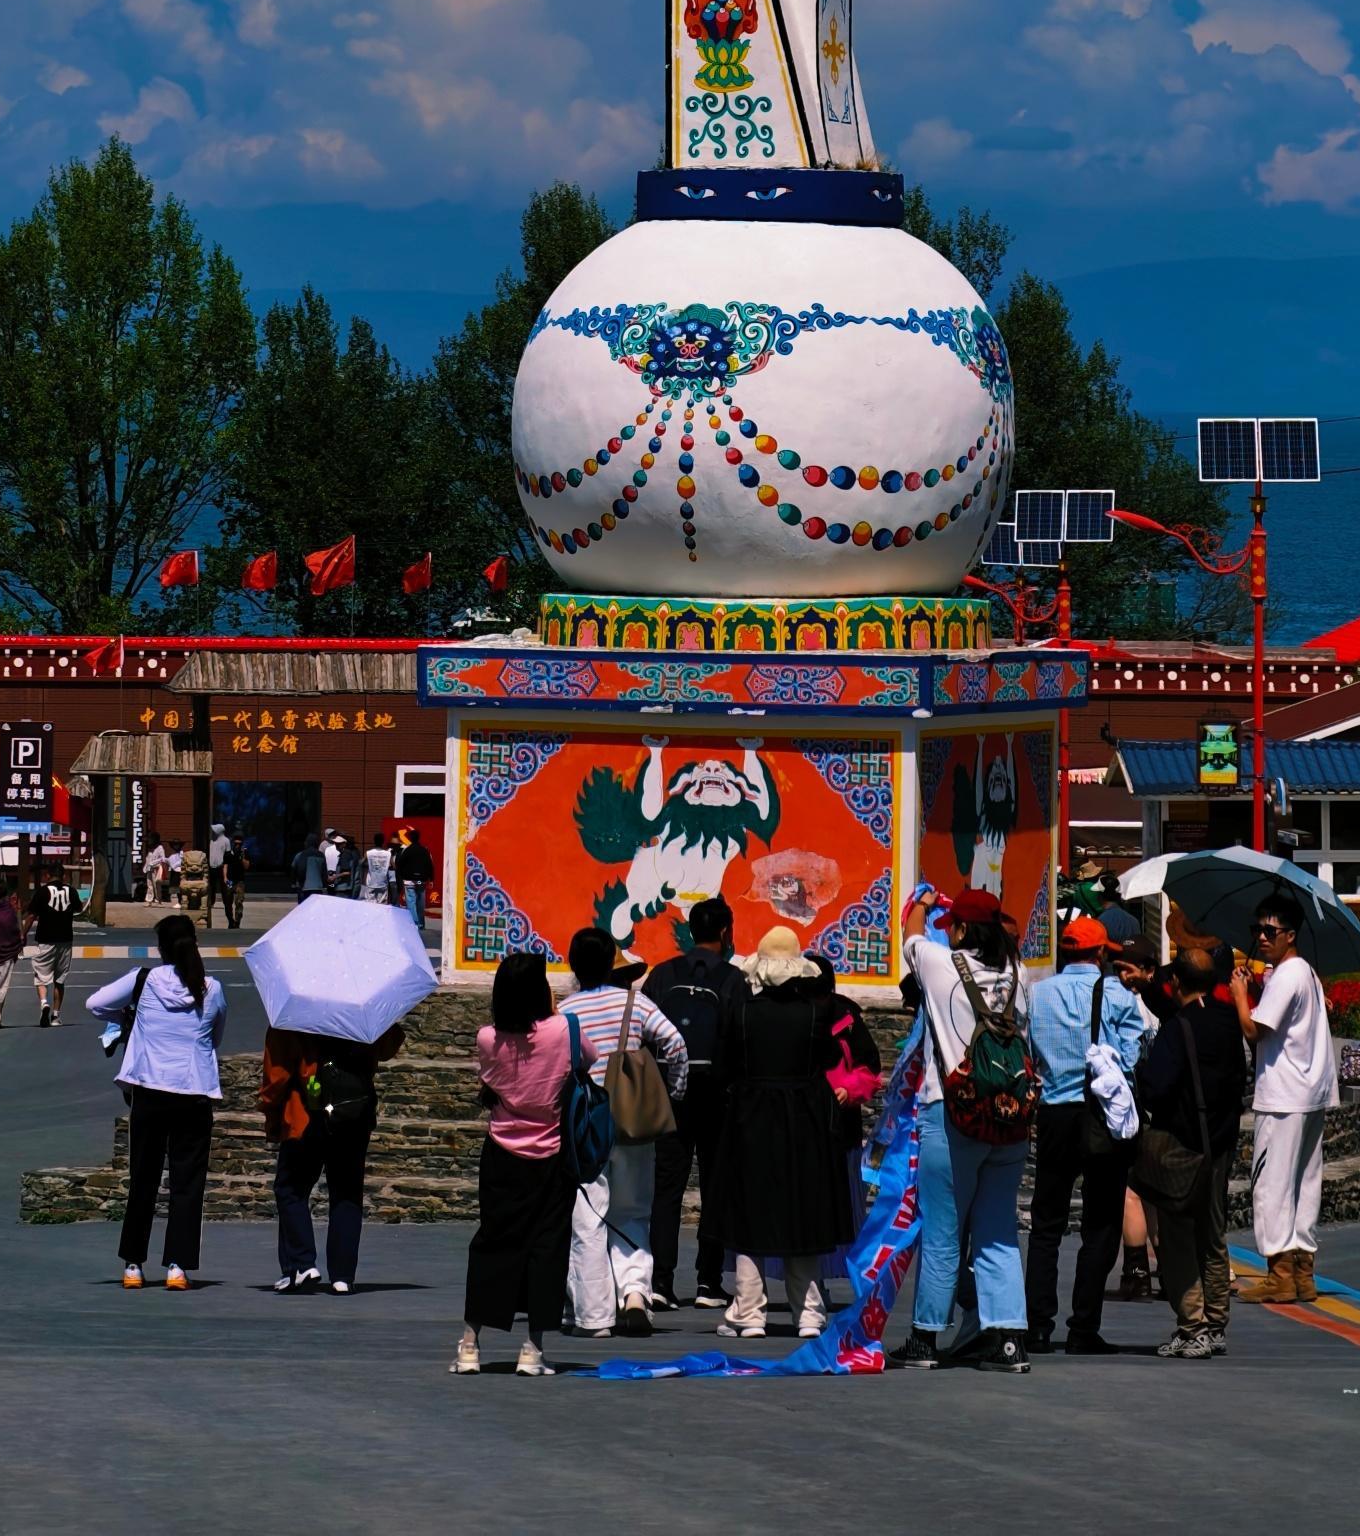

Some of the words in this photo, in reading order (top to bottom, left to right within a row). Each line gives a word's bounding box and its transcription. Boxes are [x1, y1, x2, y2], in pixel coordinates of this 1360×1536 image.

[139, 707, 397, 732] 中国一代鱼雷试验基地
[18, 741, 35, 765] P
[232, 734, 300, 754] 纪念馆
[10, 772, 41, 785] 备用
[6, 787, 45, 800] 停车场
